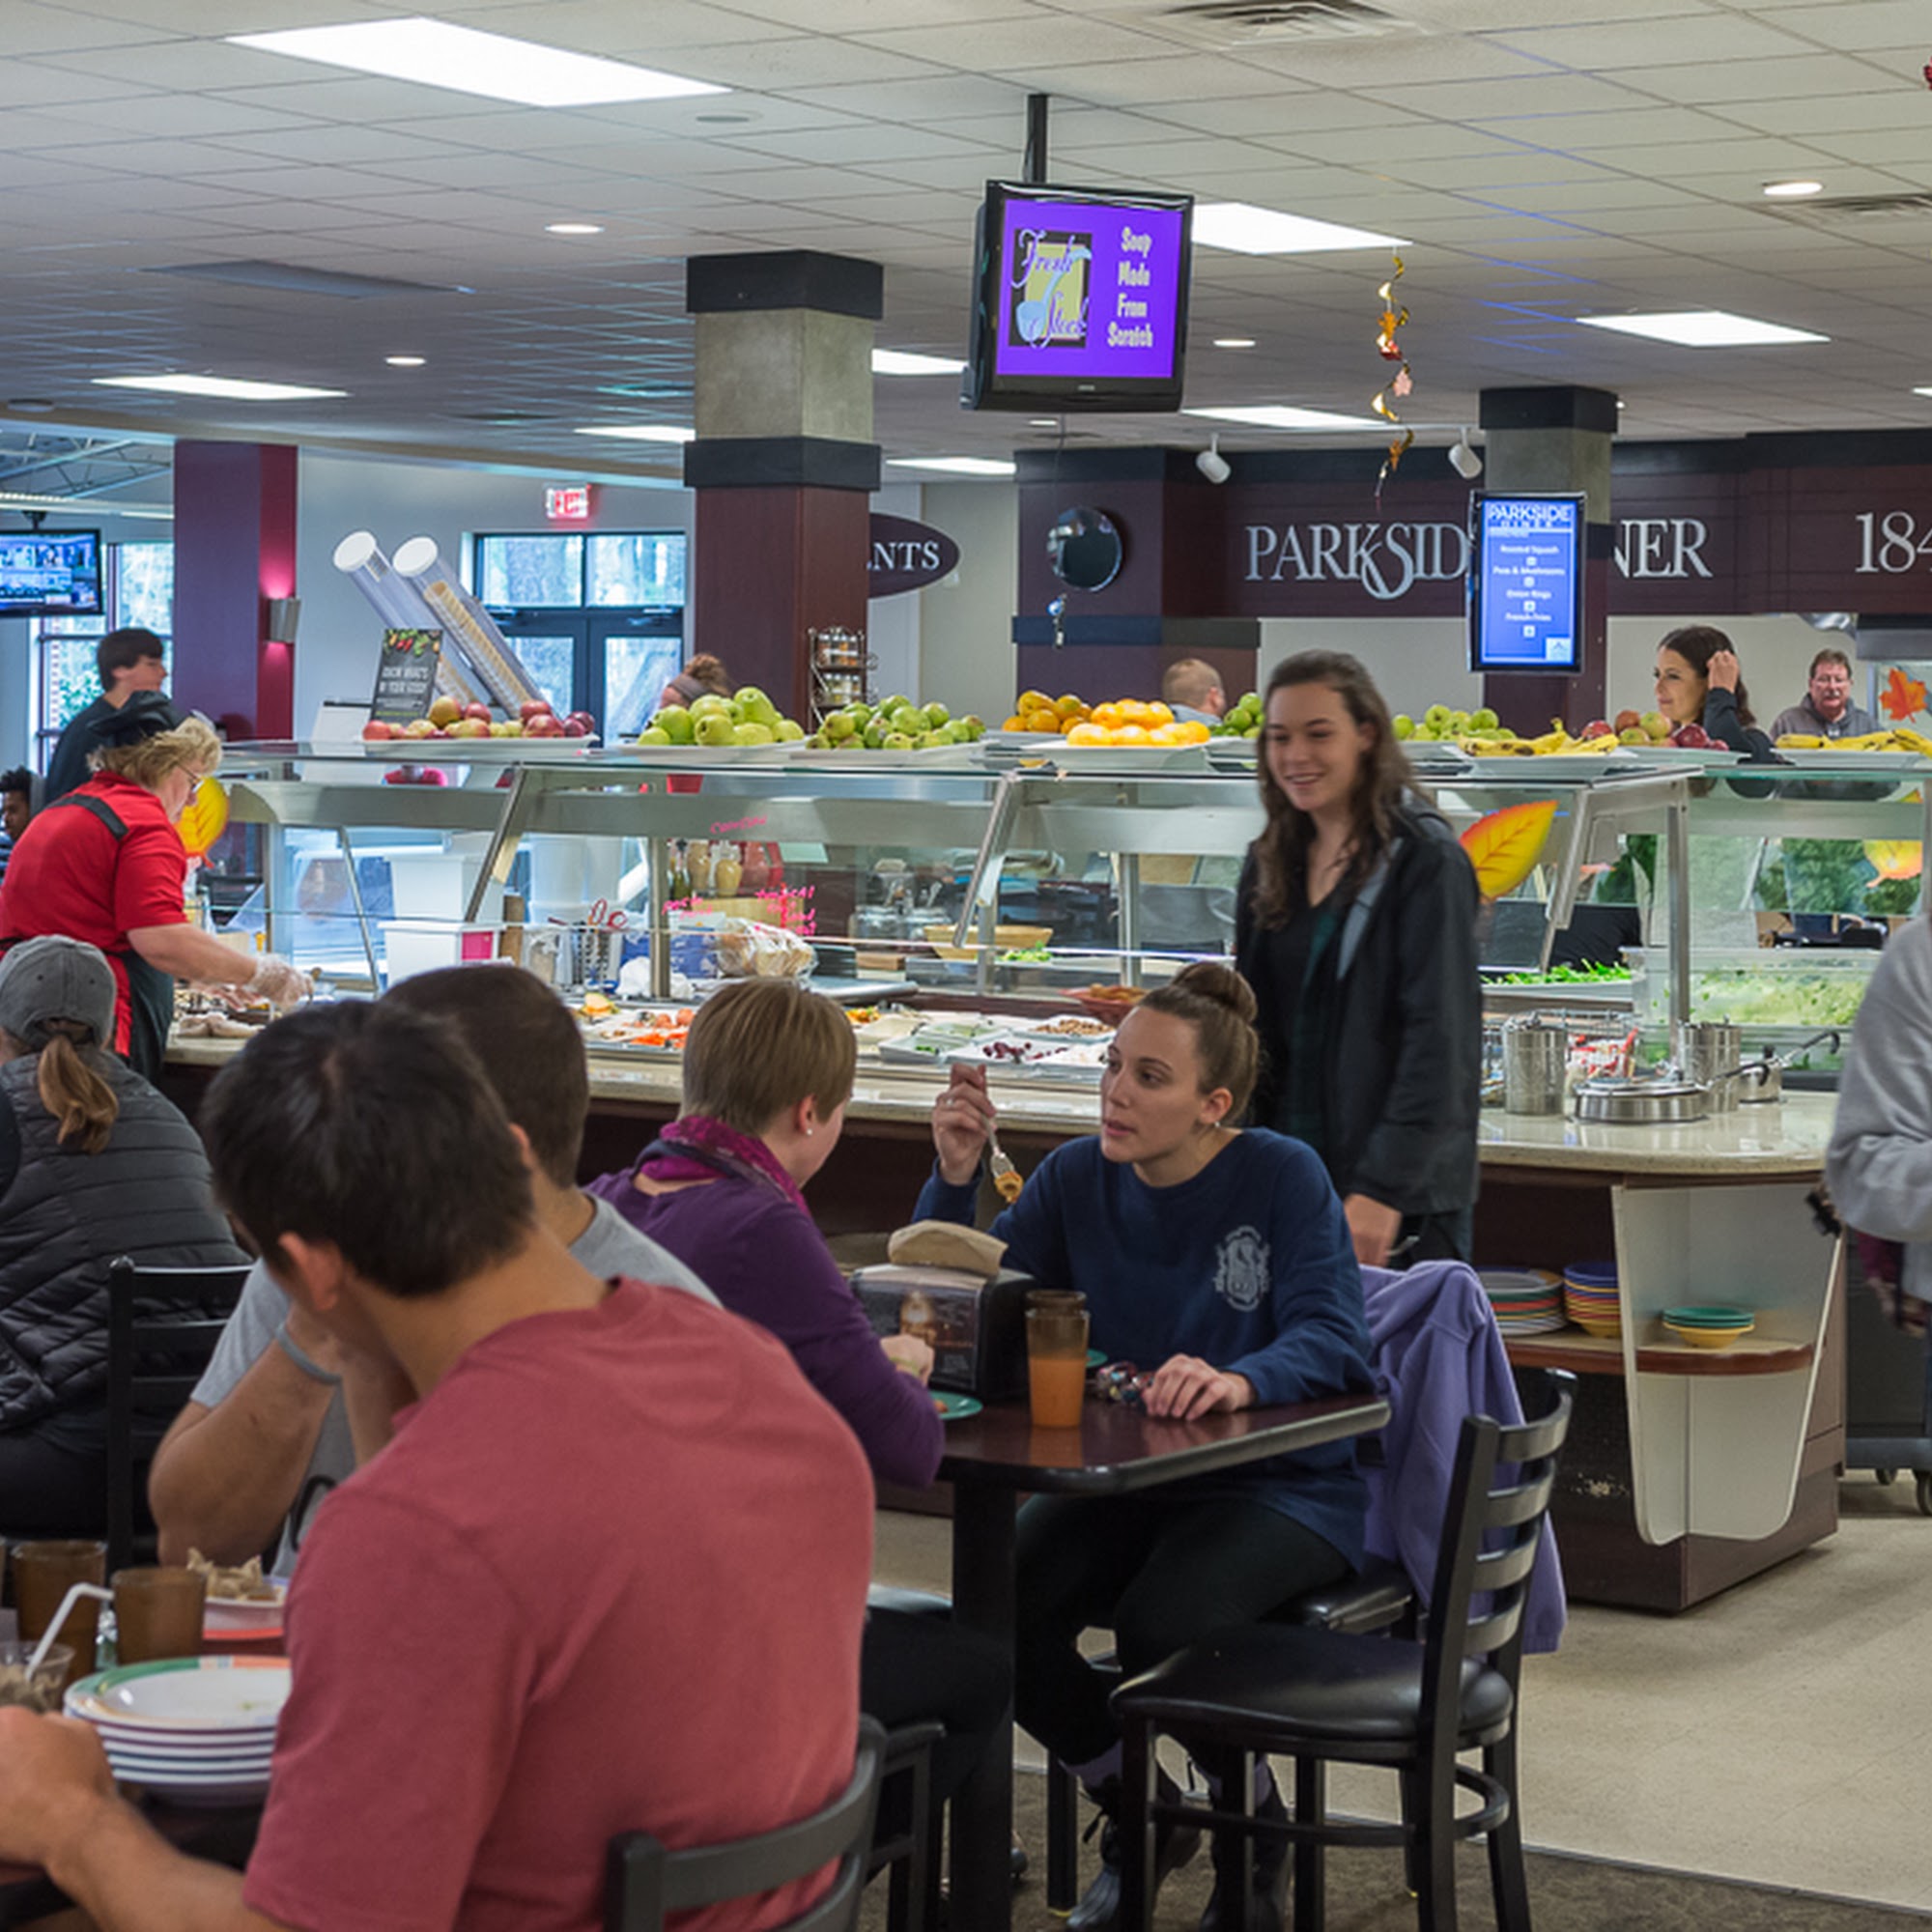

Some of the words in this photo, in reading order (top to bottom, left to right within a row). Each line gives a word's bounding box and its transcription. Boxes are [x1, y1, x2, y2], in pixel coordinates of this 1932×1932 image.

[1122, 226, 1151, 258] Soup
[1118, 261, 1150, 286] Made
[1117, 293, 1147, 317] From
[1107, 322, 1153, 347] Scratch
[1489, 504, 1571, 521] PARKSIDE
[867, 540, 940, 571] NTS
[1244, 523, 1468, 599] PARKSID
[1614, 518, 1714, 579] NER
